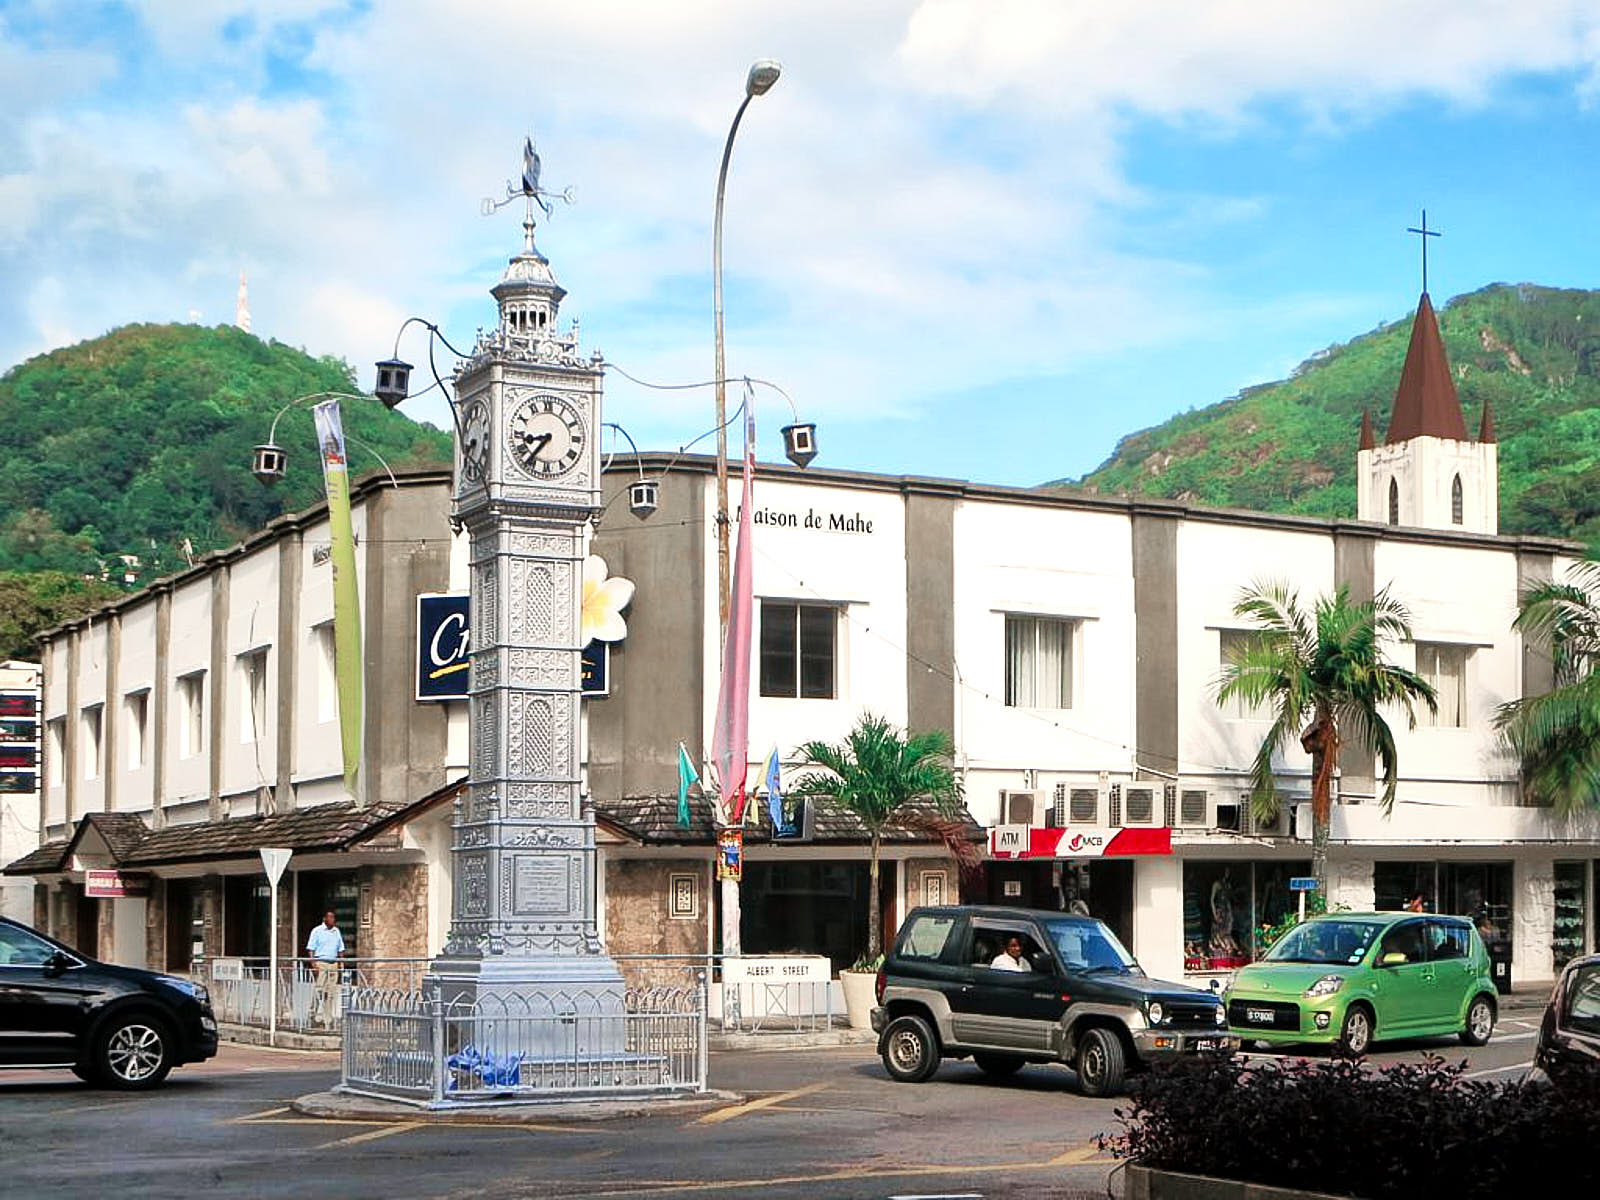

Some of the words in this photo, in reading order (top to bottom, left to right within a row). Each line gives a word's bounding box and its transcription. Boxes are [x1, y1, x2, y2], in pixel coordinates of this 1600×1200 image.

[736, 505, 797, 527] aison
[804, 508, 822, 529] de
[828, 512, 873, 534] Mahe
[1001, 832, 1019, 846] ATM
[1083, 837, 1102, 846] MCB
[746, 966, 774, 976] ALBERT
[782, 966, 809, 976] STREET
